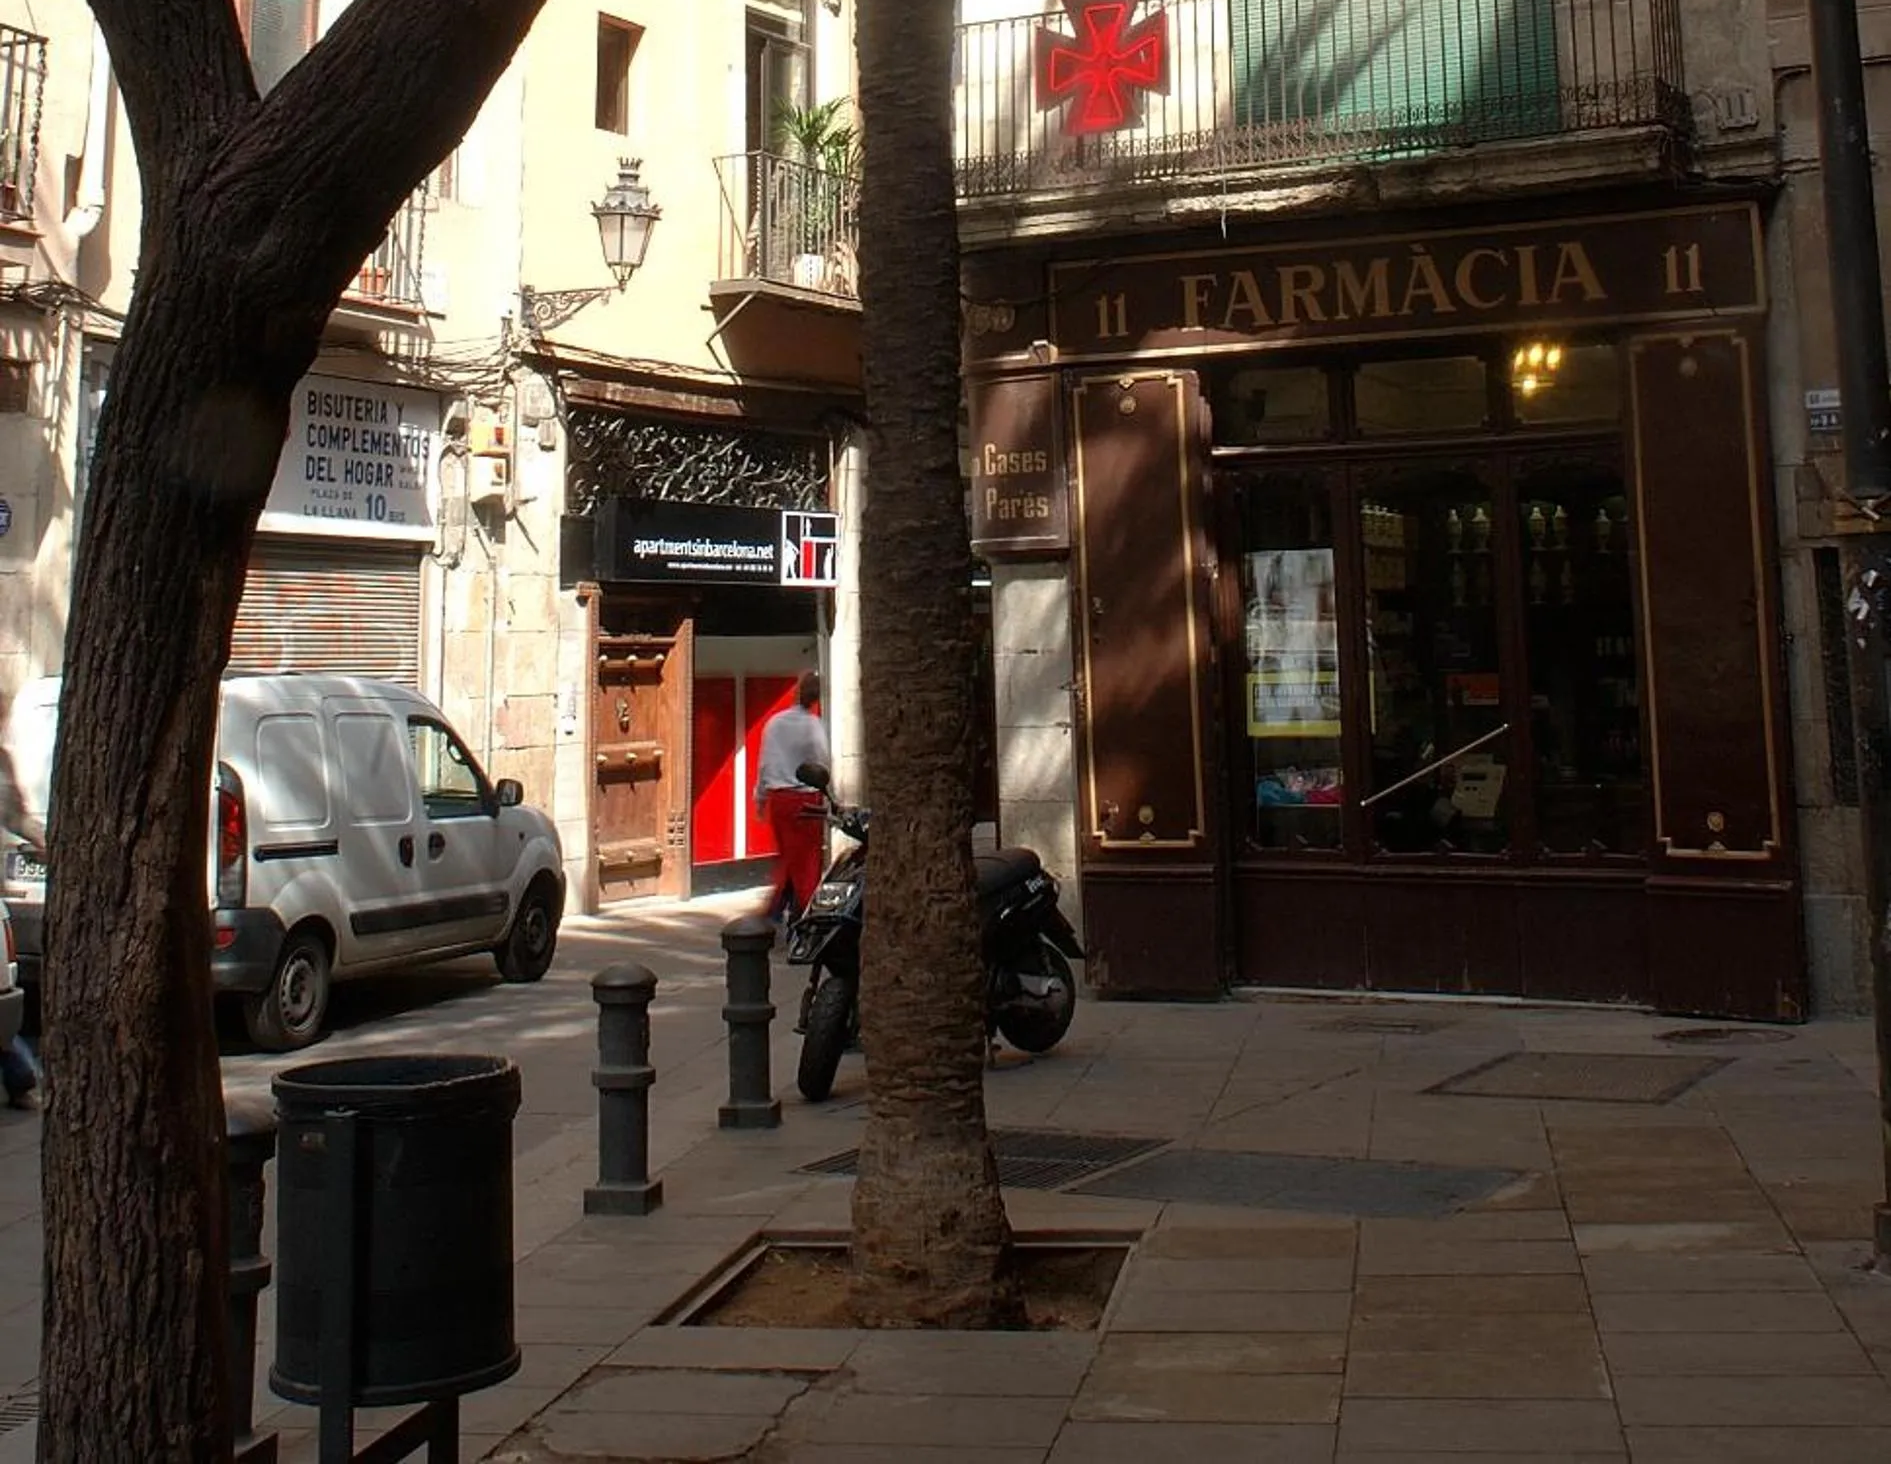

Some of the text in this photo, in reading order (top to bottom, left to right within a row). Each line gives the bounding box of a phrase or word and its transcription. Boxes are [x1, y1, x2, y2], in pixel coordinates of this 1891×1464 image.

[1095, 242, 1704, 337] 11 FARMÀCIA 11
[306, 390, 405, 427] BISUTERIA Y
[306, 423, 430, 460] COMPLEMENTOS
[984, 442, 1048, 476] Cases
[305, 454, 337, 483] DEL
[344, 458, 394, 489] HOGAR
[366, 492, 387, 522] 10
[633, 538, 774, 560] apartmentsinbarcelona.net
